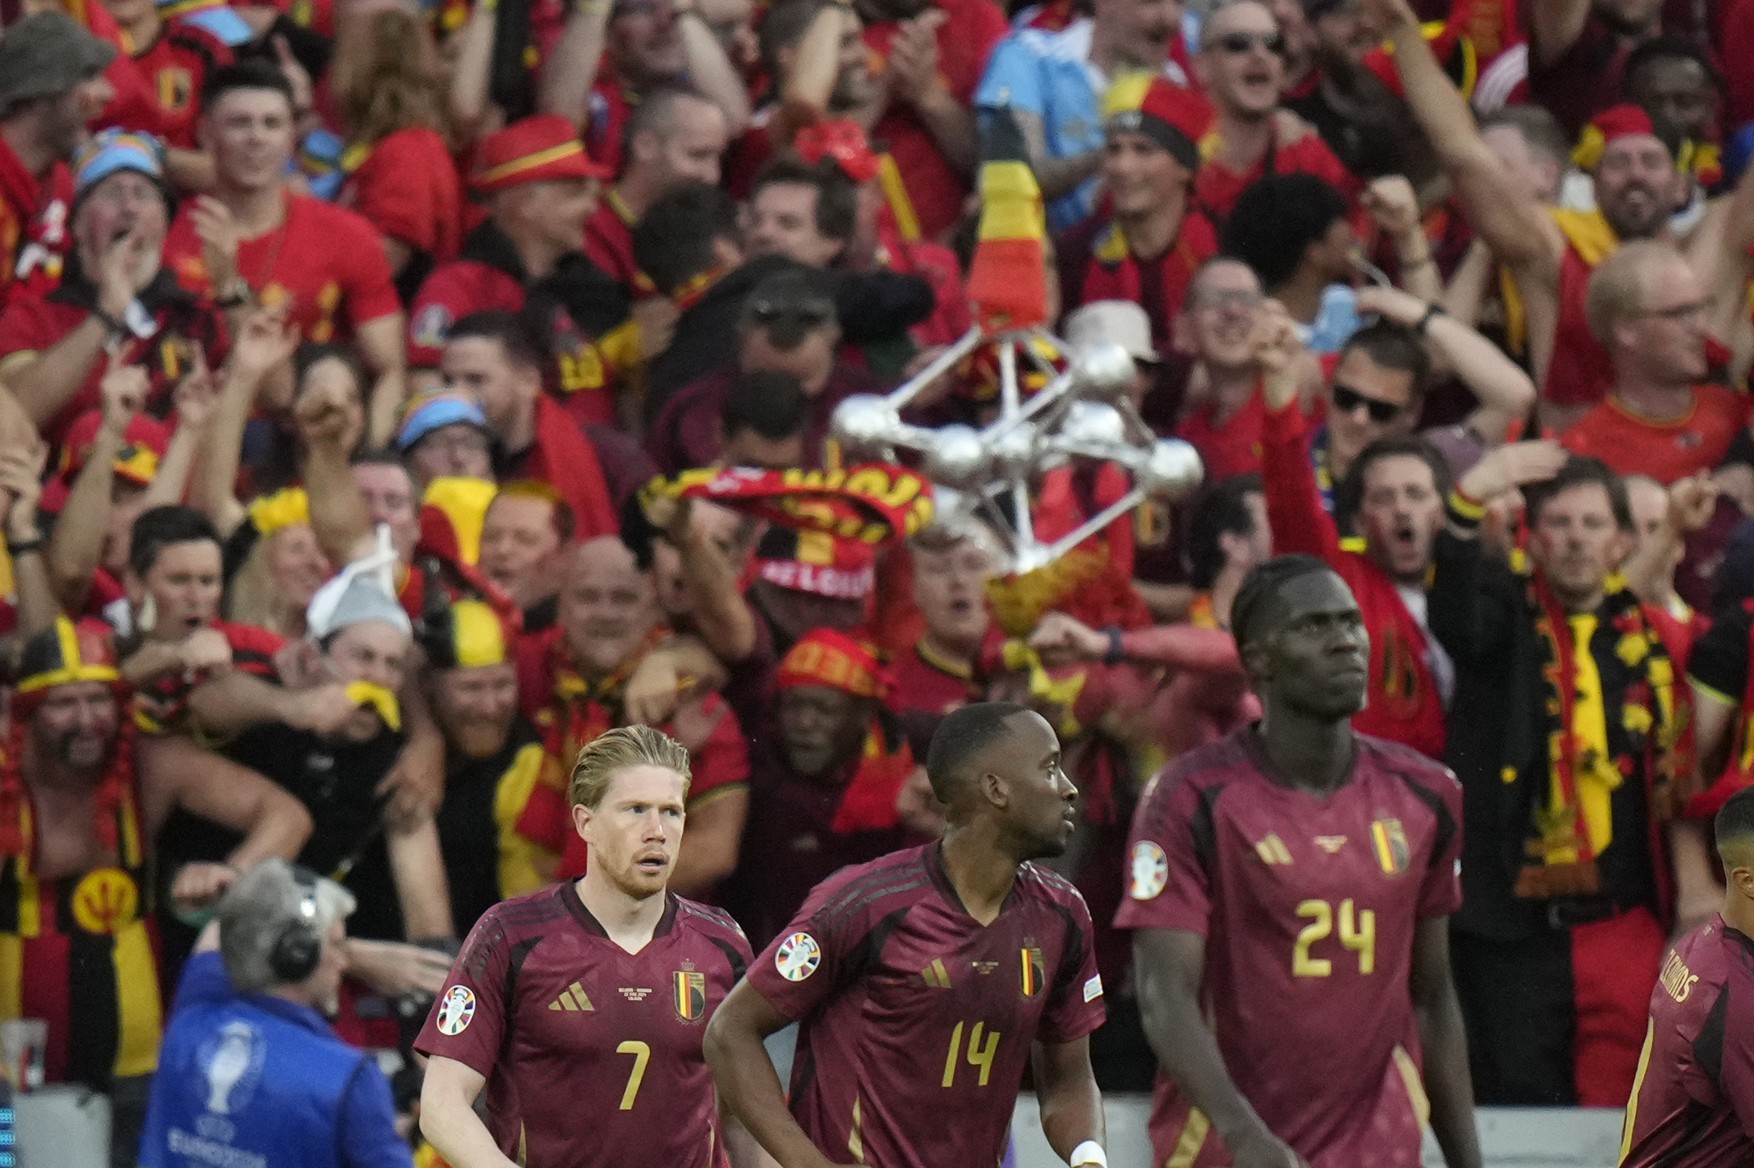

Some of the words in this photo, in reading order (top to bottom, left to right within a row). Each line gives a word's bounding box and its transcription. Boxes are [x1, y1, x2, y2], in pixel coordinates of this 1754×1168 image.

[1291, 898, 1377, 978] 24
[615, 1040, 651, 1111] 7
[941, 1020, 1001, 1088] 14
